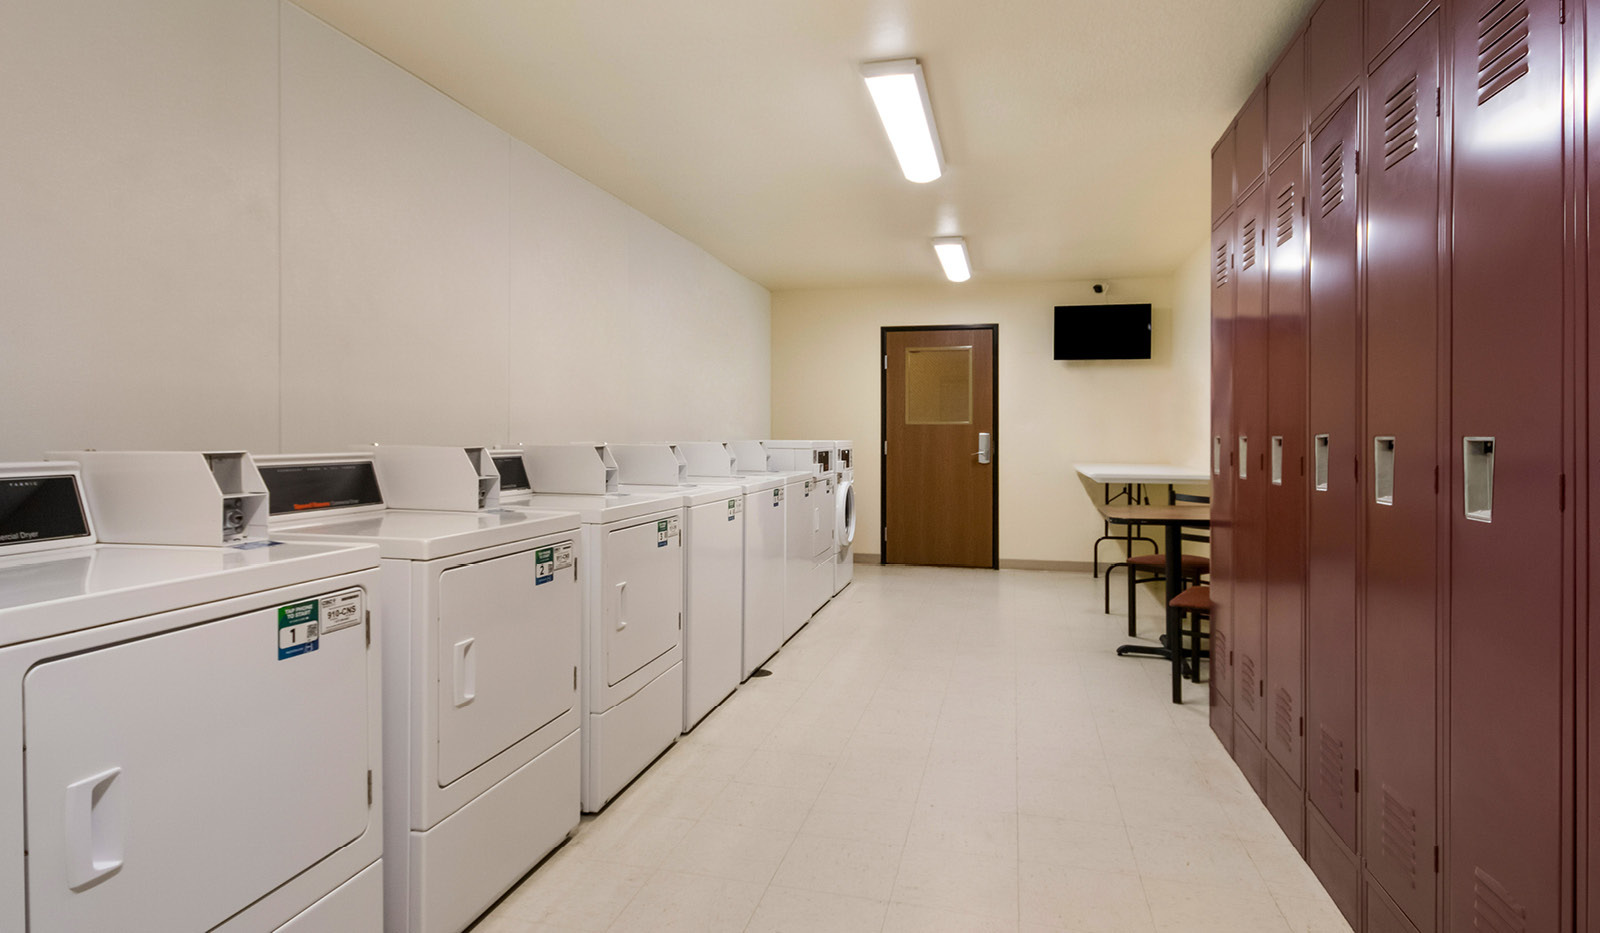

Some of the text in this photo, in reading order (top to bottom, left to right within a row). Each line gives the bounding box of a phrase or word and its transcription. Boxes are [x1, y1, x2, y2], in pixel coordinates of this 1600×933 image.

[19, 531, 39, 540] Dryer
[540, 565, 545, 575] 2
[295, 610, 311, 618] START
[327, 605, 356, 619] 910-CNS
[290, 628, 296, 643] 1
